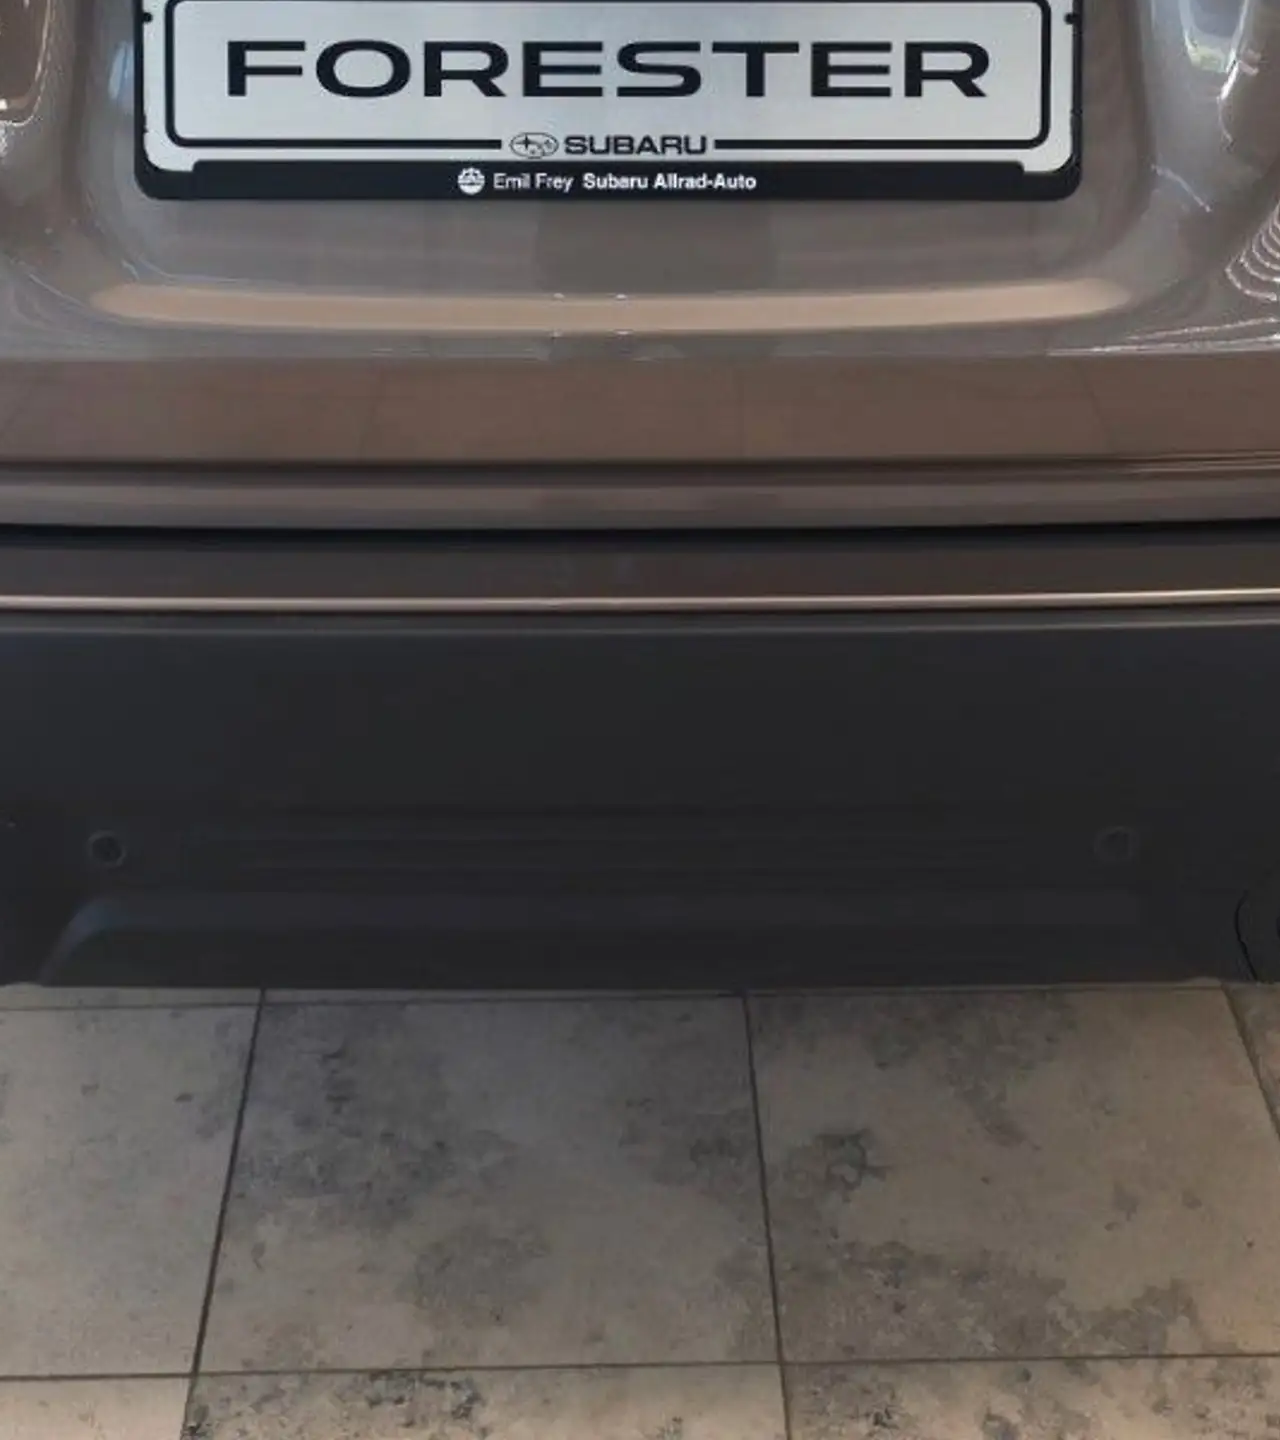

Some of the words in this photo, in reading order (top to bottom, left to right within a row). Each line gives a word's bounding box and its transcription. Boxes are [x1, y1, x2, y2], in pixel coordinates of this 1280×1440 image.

[226, 40, 991, 98] FORESTER
[564, 135, 708, 156] SUBARU
[493, 173, 530, 190] Emil
[536, 173, 574, 193] Frey
[583, 172, 648, 190] Subaru
[654, 172, 757, 190] Allrad-Auto
